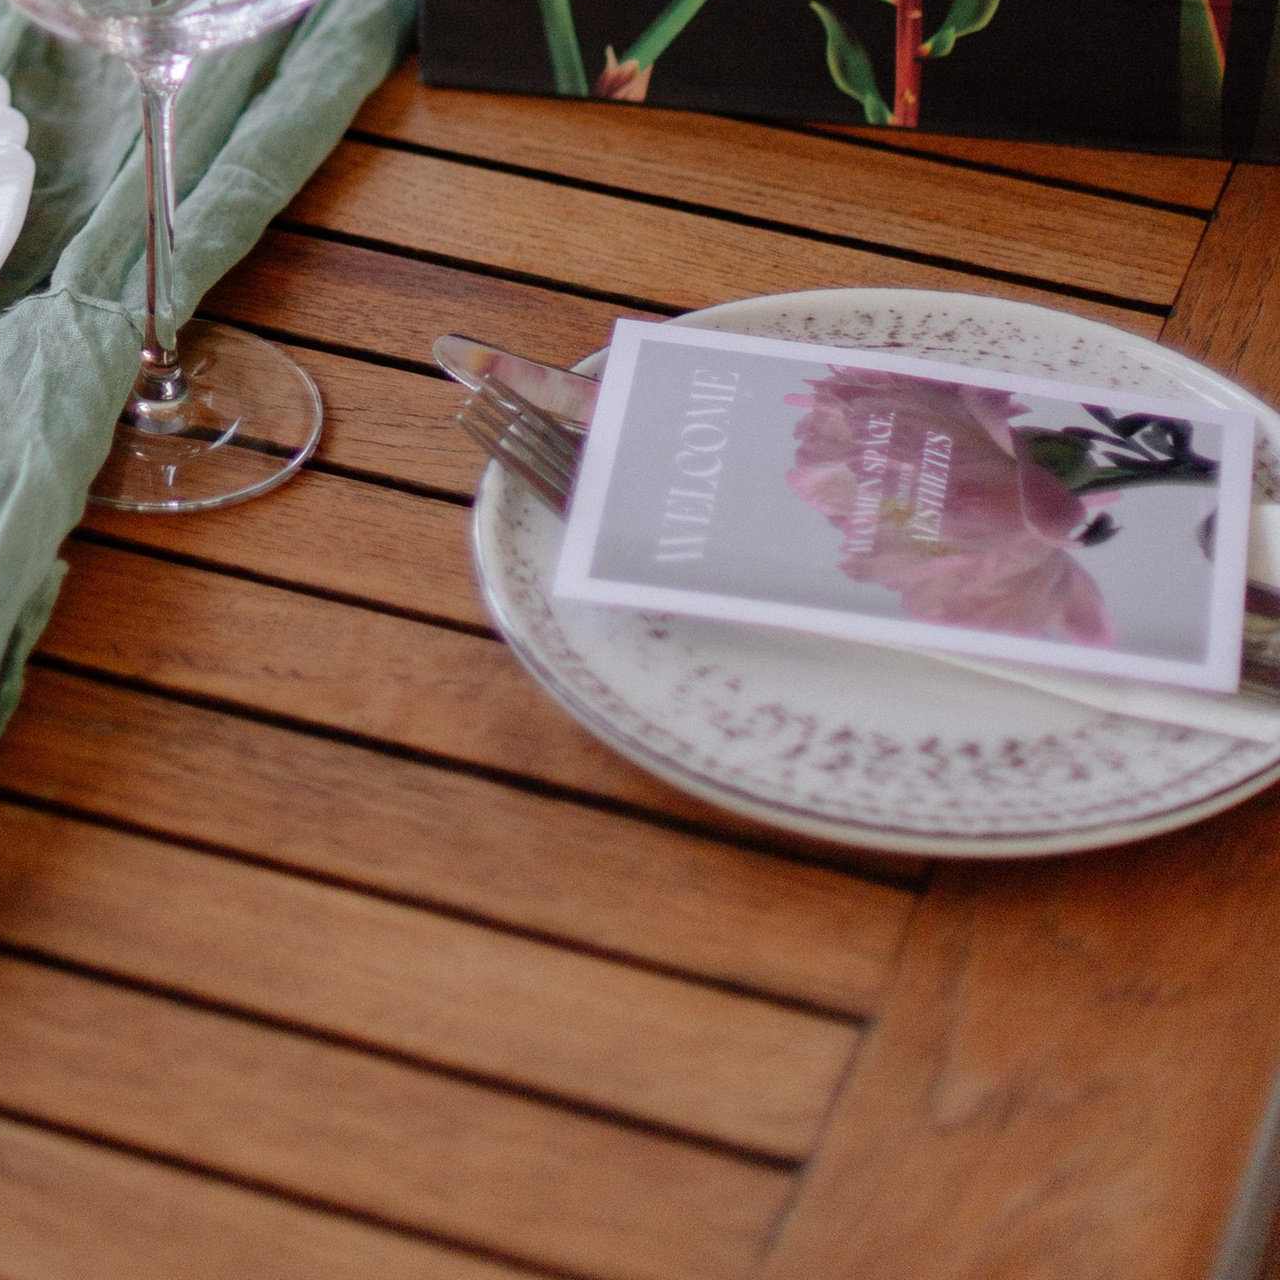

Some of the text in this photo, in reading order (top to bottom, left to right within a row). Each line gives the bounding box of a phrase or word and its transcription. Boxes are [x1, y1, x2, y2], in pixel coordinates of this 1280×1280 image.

[654, 369, 740, 562] WELCOME
[848, 477, 884, 553] WOMEN
[911, 431, 953, 541] AESTHETES
